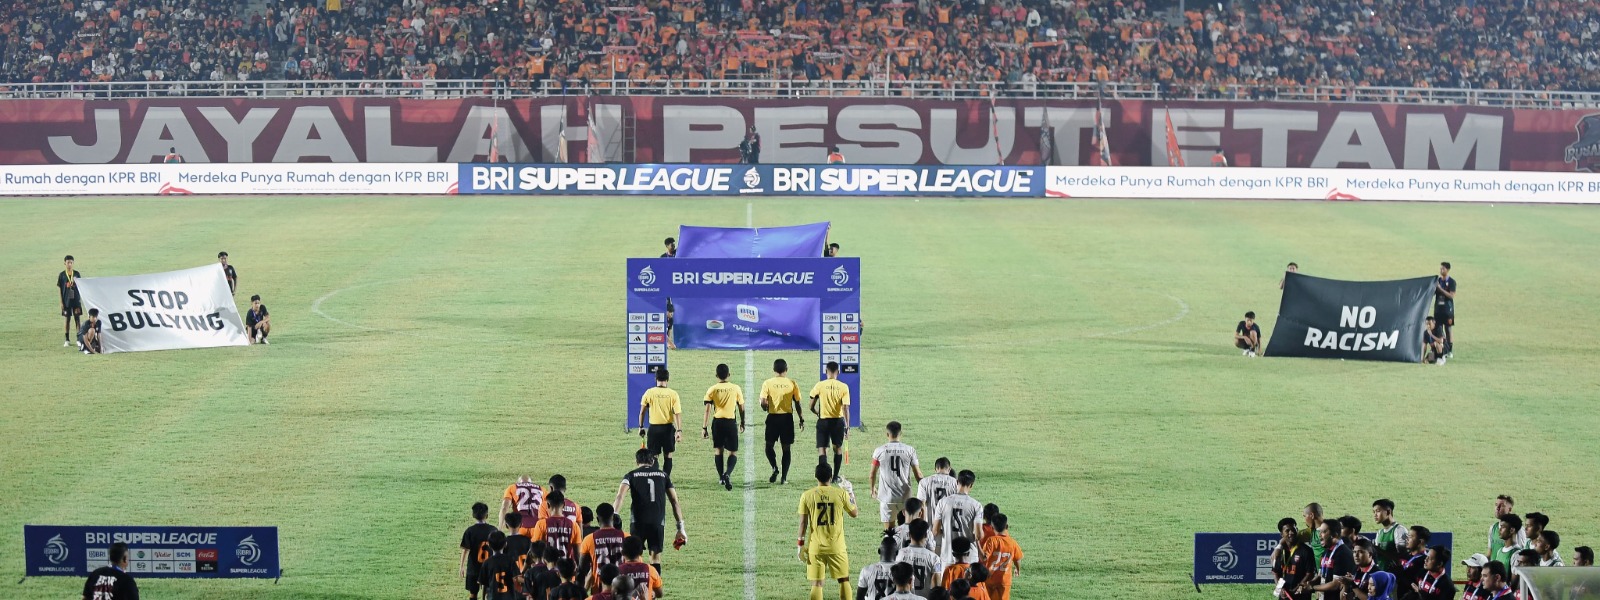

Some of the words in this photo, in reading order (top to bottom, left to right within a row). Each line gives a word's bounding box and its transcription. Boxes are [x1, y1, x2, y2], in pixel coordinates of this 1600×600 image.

[48, 104, 622, 164] JAYALAH
[663, 104, 1111, 167] PESUT
[1152, 108, 1504, 172] ETAM
[5, 173, 51, 184] Rumah
[54, 173, 105, 189] dengan
[108, 173, 135, 184] KPR
[139, 173, 161, 184] BRI
[178, 173, 237, 184] Merdeka
[241, 173, 283, 188] Punya
[287, 172, 336, 184] Rumah
[339, 172, 391, 188] dengan
[395, 172, 423, 184] KPR
[427, 172, 449, 184] BRI
[472, 167, 514, 191] BRI
[773, 168, 816, 192] BRI
[1056, 174, 1116, 187] Merdeka
[1120, 175, 1161, 190] Punya
[1166, 175, 1215, 188] Rumah
[1219, 176, 1272, 191] dengan
[1275, 177, 1304, 188] KPR
[1307, 177, 1329, 189] BRI
[1346, 178, 1404, 190] Merdeka
[1408, 178, 1450, 194] Punya
[1454, 179, 1501, 192] Rumah
[1504, 180, 1554, 196] dengan
[1558, 181, 1584, 192] KPR
[672, 271, 699, 285] BRI
[128, 289, 189, 310] STOP
[108, 311, 225, 332] BULLYING
[1340, 305, 1377, 329] NO
[1304, 327, 1400, 352] RACISM
[890, 455, 901, 478] 4
[516, 487, 543, 511] 23
[647, 478, 656, 502] 1
[817, 502, 835, 526] 21
[86, 532, 111, 544] BRI
[1256, 539, 1278, 551] BR
